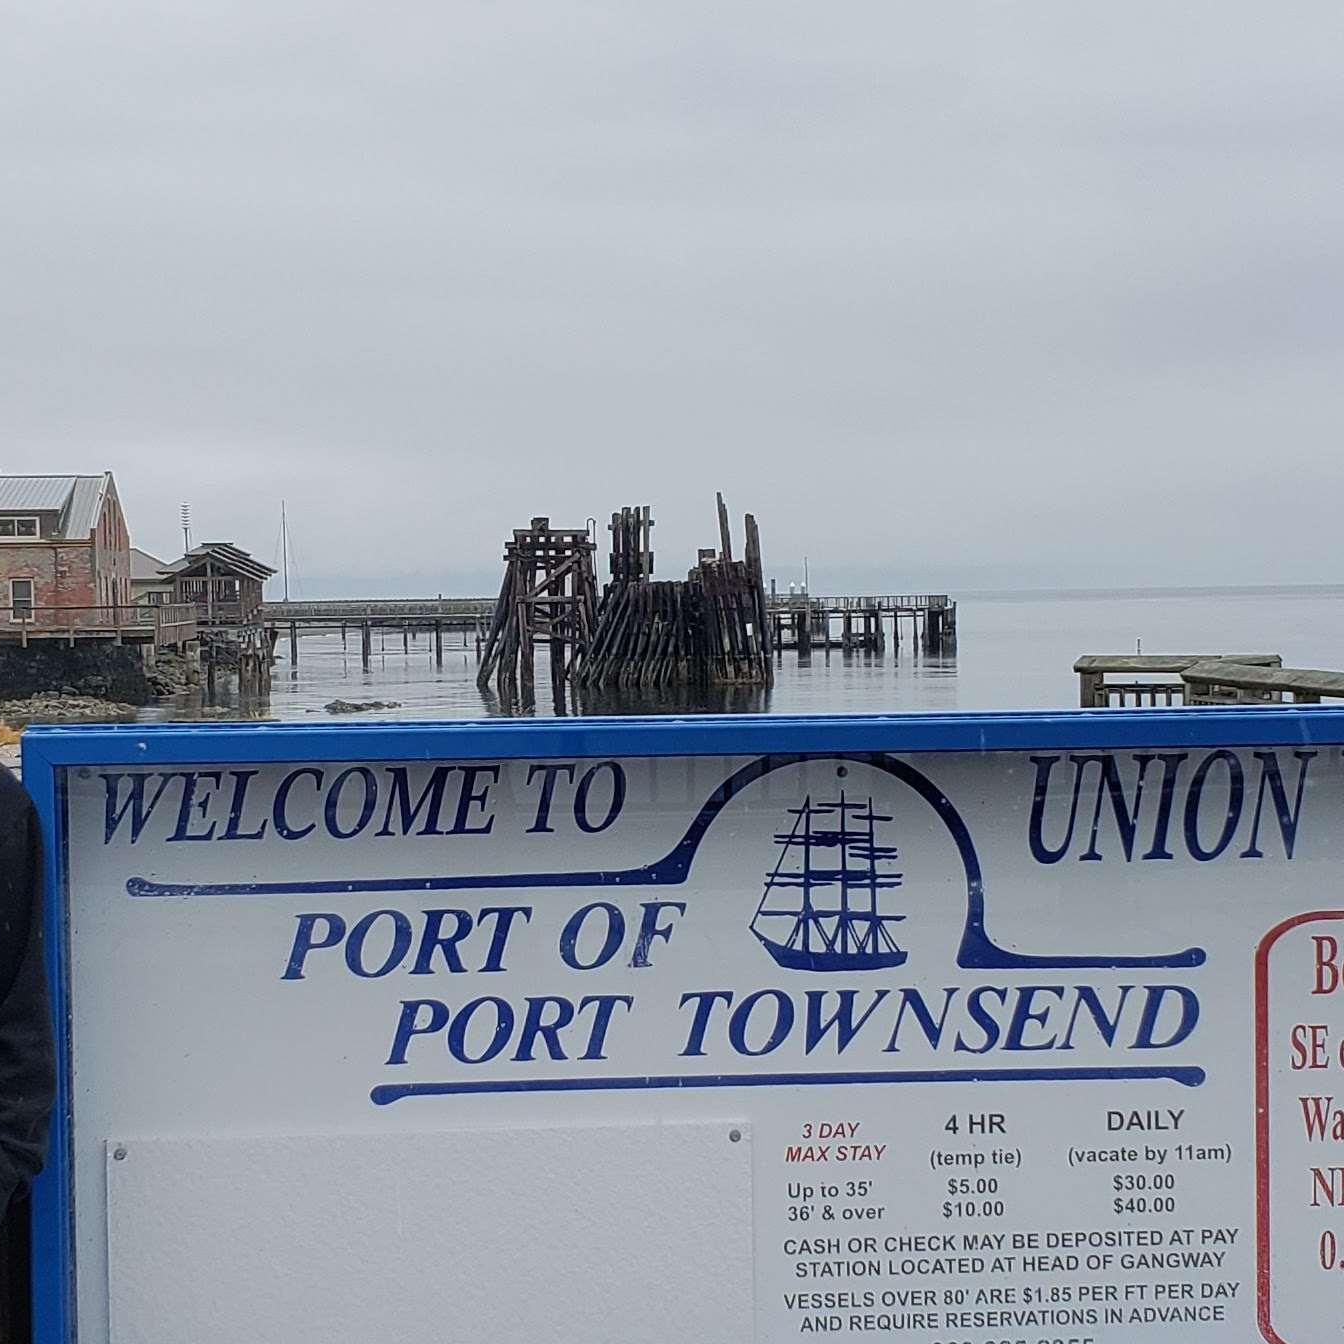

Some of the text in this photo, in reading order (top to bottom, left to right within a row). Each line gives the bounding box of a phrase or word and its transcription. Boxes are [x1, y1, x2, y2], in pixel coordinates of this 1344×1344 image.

[98, 760, 627, 845] WELCOME TO
[1027, 749, 1319, 864] UNION
[280, 902, 687, 980] PORT OF
[384, 985, 1200, 1065] PORT TOWNSEND
[1291, 1025, 1330, 1070] SE
[802, 1122, 860, 1140] 3 DAY
[945, 1114, 1007, 1135] 4 HR
[1107, 1109, 1185, 1131] DAILY
[786, 1145, 886, 1162] MAX STAY
[930, 1148, 1021, 1169] (temp tie)
[1069, 1144, 1231, 1166] (vacate by 11am)
[788, 1181, 872, 1202] Up to 35'
[948, 1178, 998, 1196] $5.00
[1113, 1174, 1174, 1192] $30.00
[788, 1205, 885, 1221] 36' & over
[943, 1199, 1004, 1219] $10.00
[1113, 1197, 1175, 1215] $40.00
[784, 1228, 1239, 1255] CASH OR CHECK MAY BE DEPOSITED AT PAY
[796, 1251, 1226, 1278] STATION LOCATED AT HEAD OF GANGWAY
[784, 1282, 1240, 1310] VESSELS OVER 80' ARE $1.85 PER FT PER DAY
[800, 1305, 1224, 1332] AND REQUIRE RESERVATIONS IN ADVANCE
